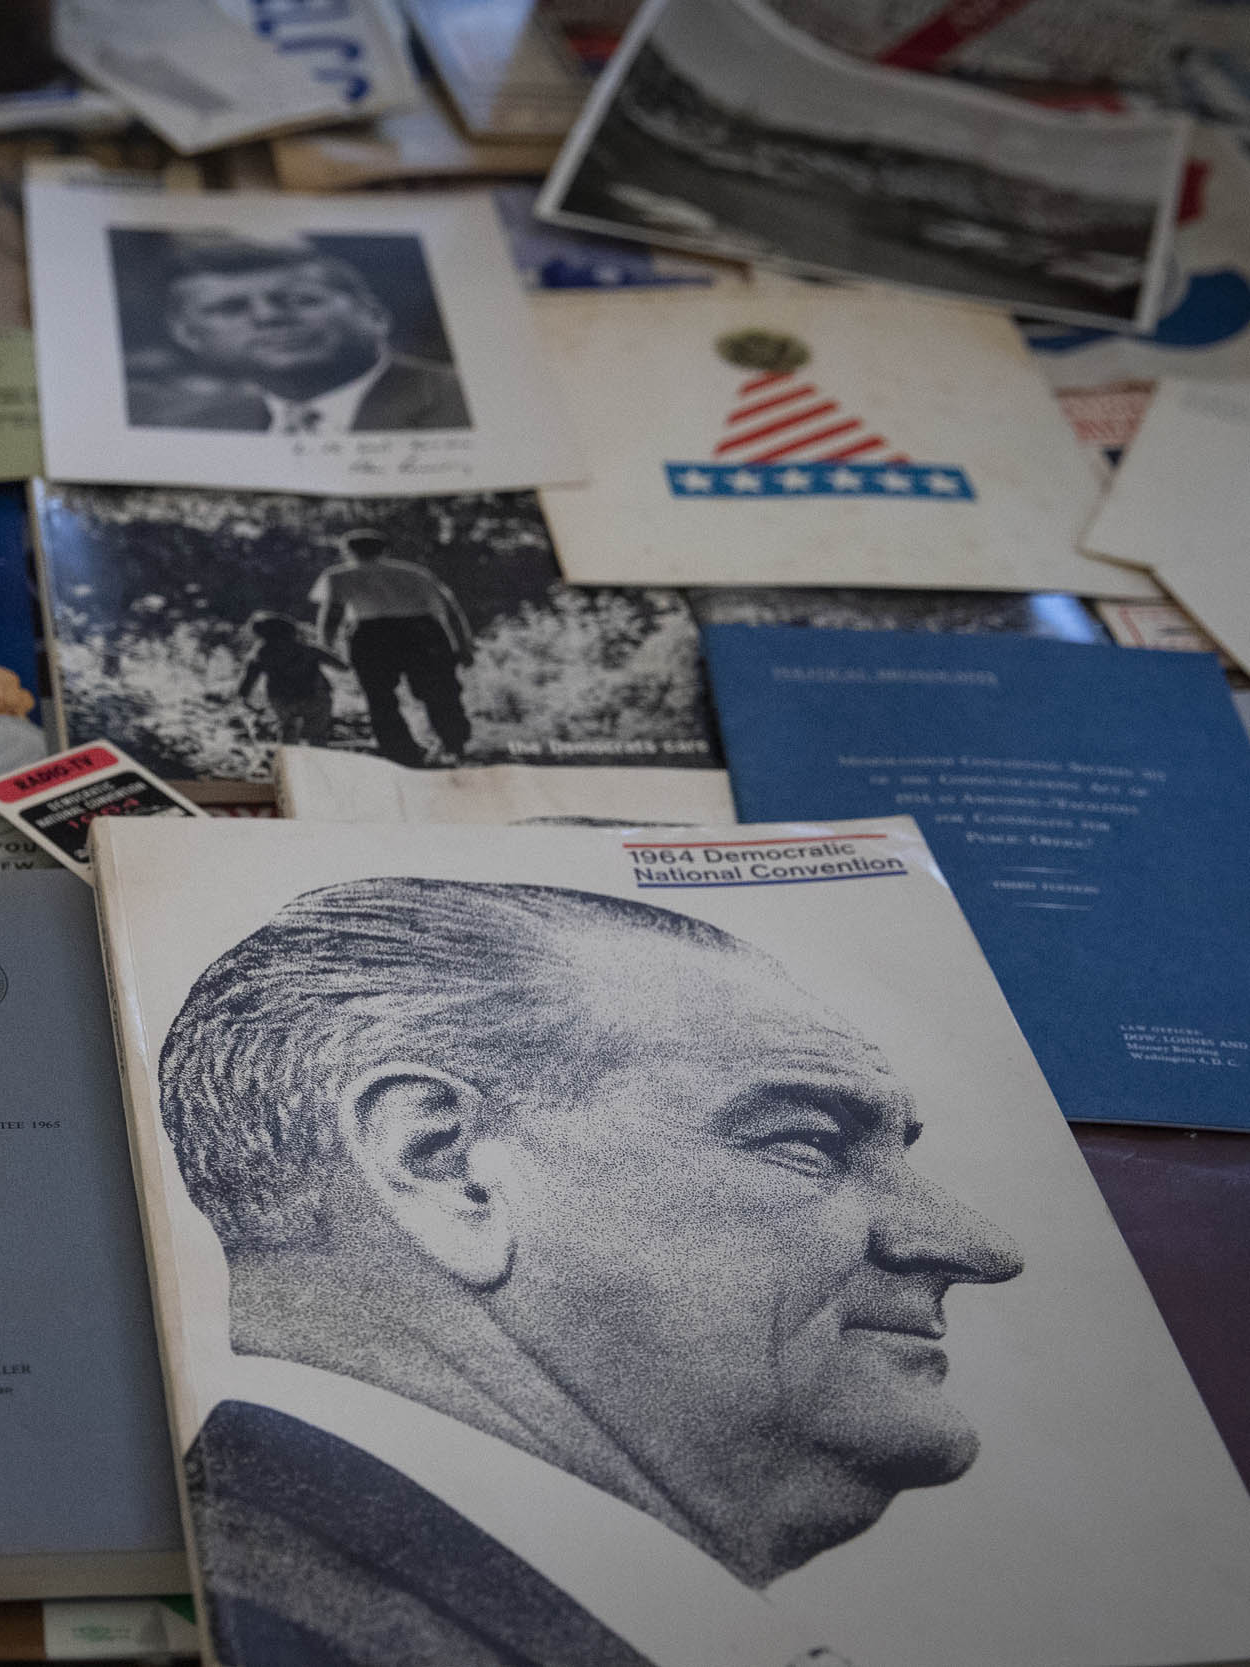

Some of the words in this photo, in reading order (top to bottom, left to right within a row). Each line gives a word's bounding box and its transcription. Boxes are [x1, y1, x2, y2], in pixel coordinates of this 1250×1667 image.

[630, 850, 695, 865] 1964
[702, 841, 856, 863] Democratic
[633, 866, 742, 883] National
[750, 856, 904, 880] Convention
[31, 1119, 61, 1130] 1965
